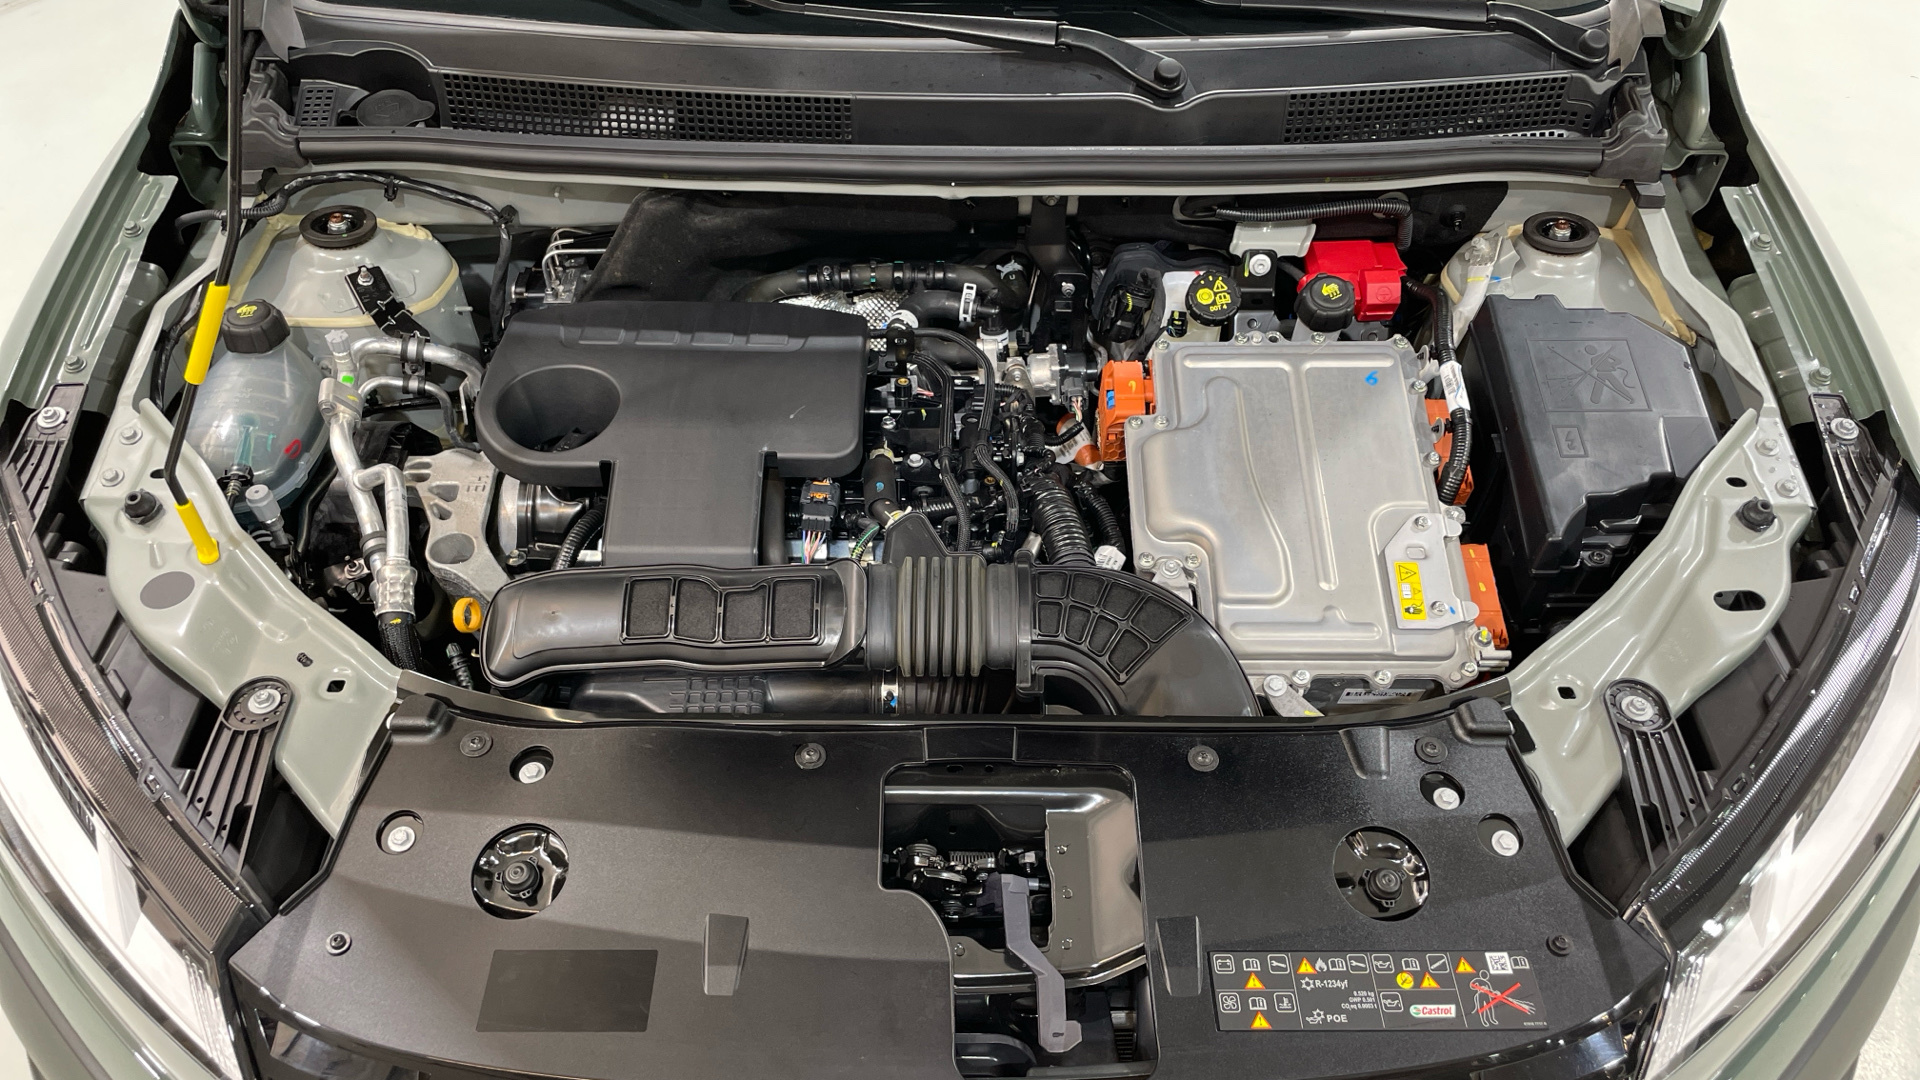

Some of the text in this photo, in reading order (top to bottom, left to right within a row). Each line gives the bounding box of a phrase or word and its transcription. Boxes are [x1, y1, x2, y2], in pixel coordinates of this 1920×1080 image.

[1364, 370, 1379, 386] 6
[1314, 980, 1348, 990] R-1234yf
[1421, 1006, 1452, 1016] Castrol
[1326, 1014, 1348, 1023] POE
